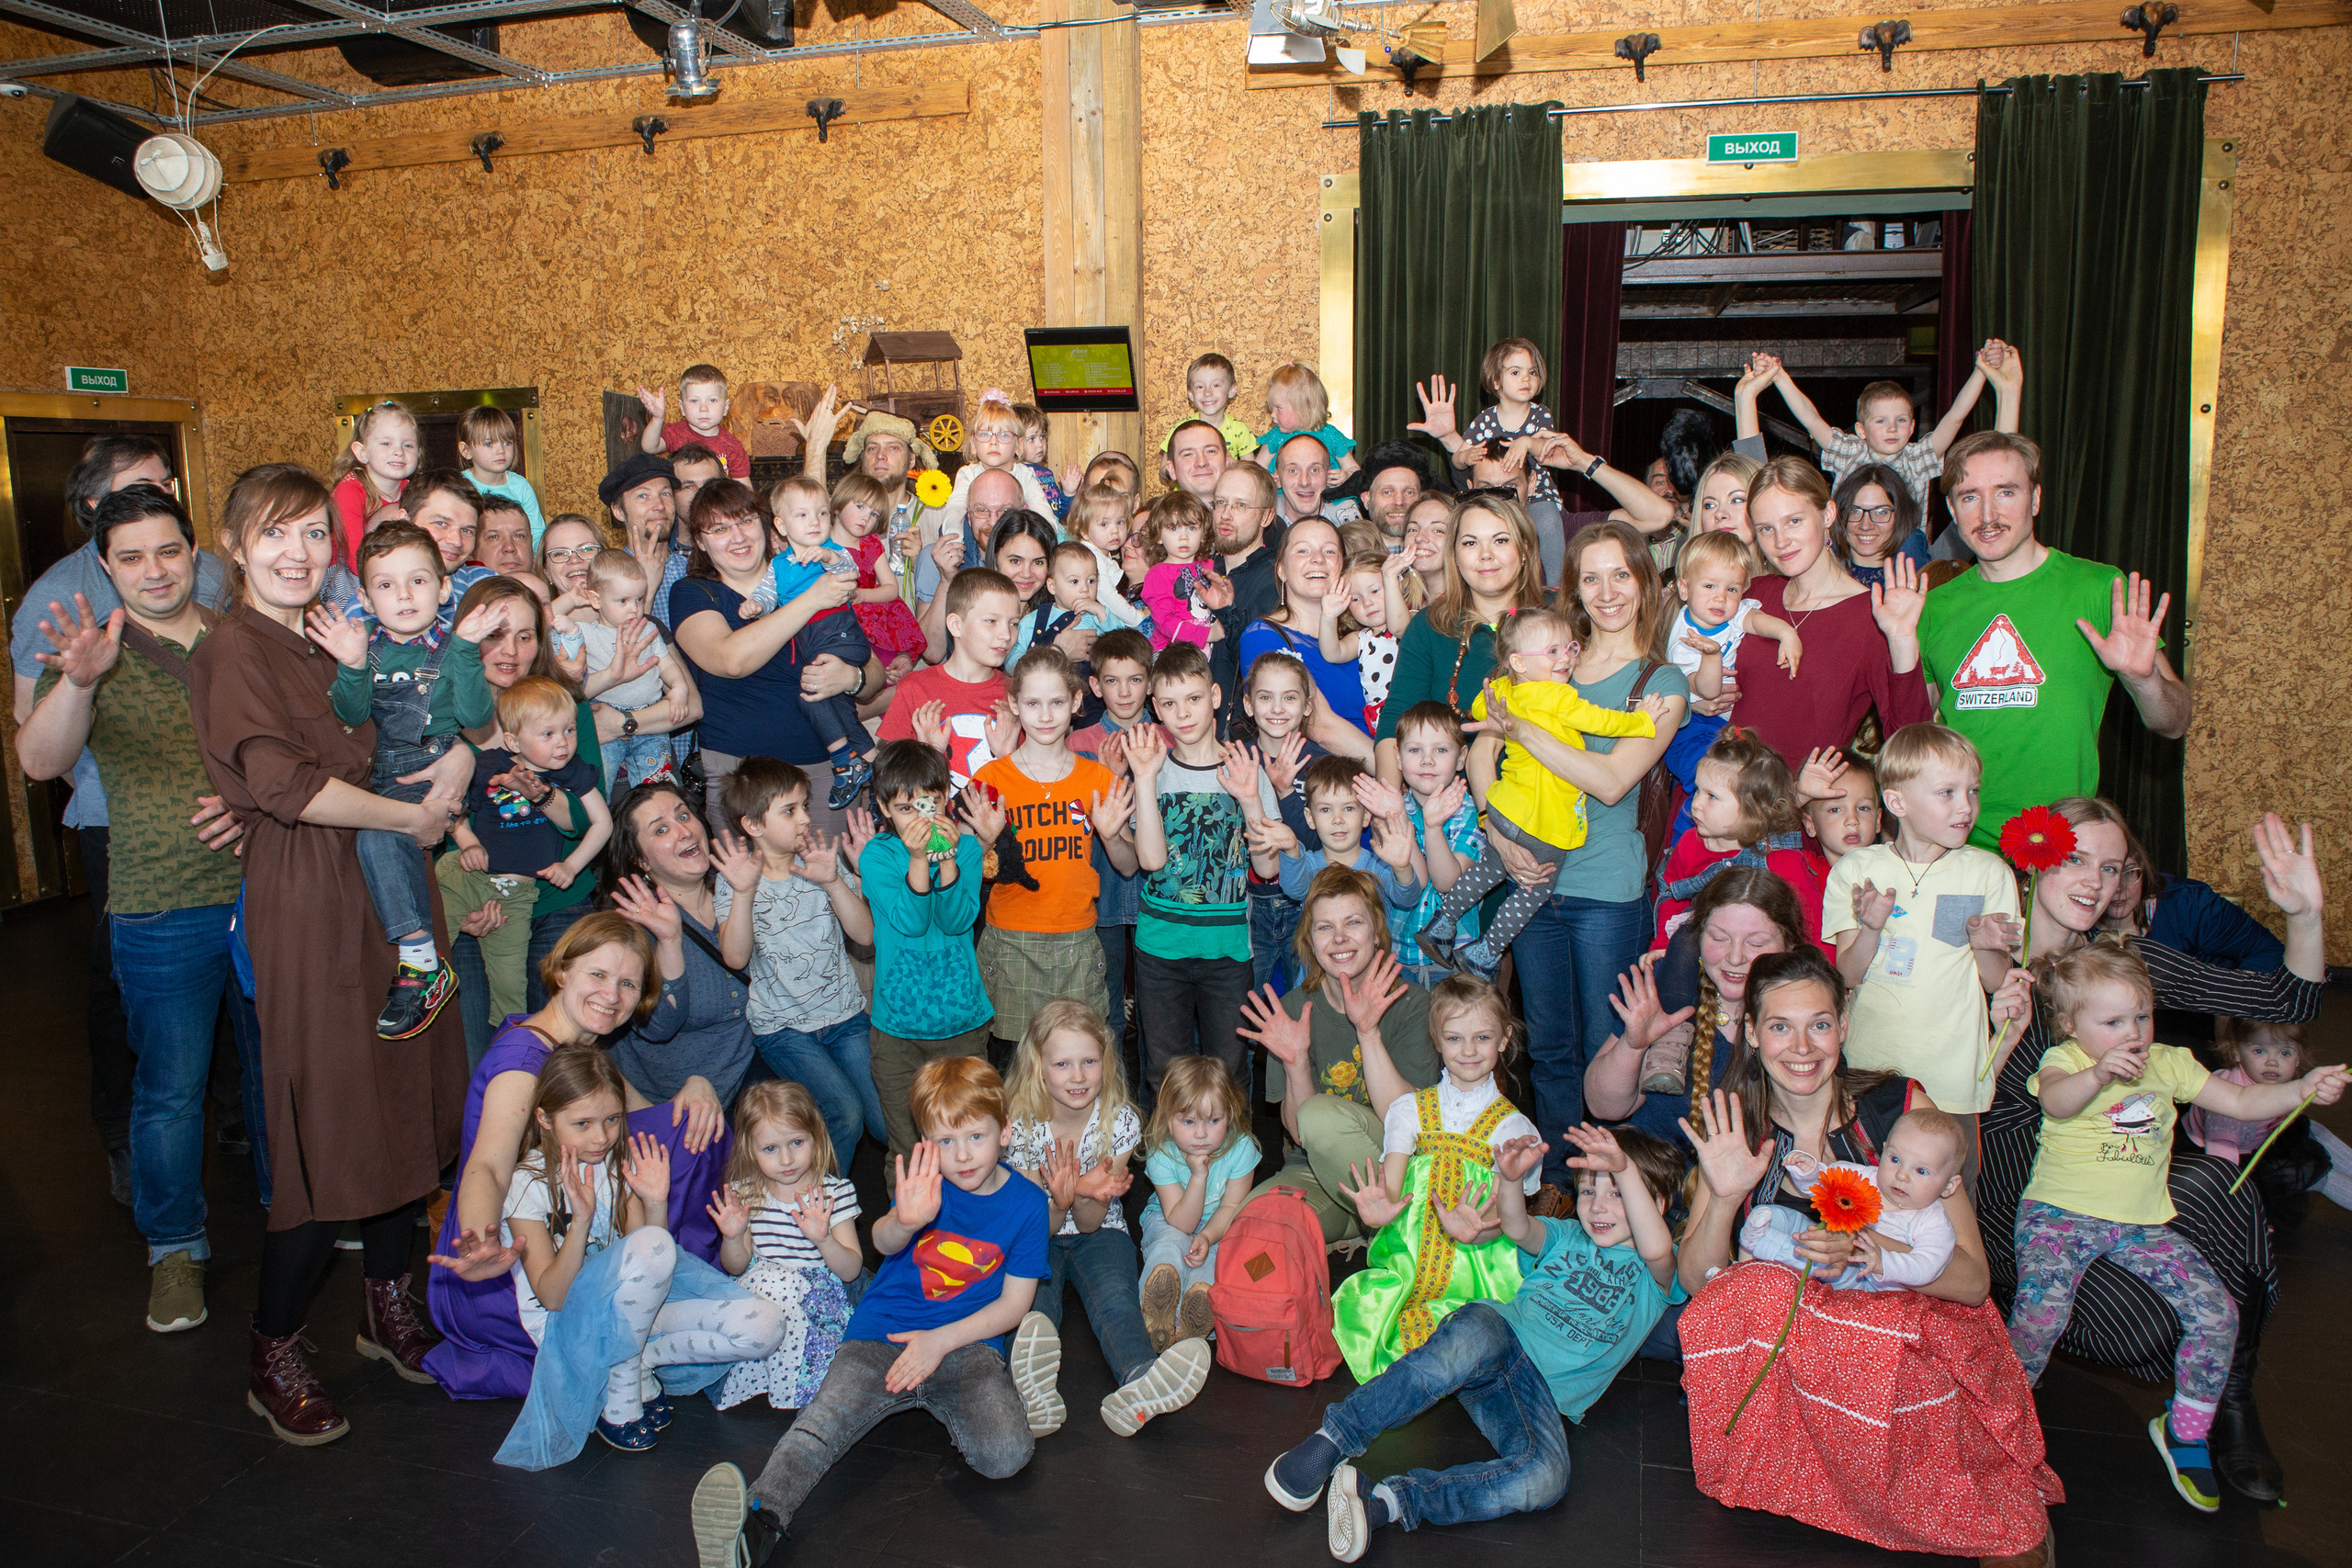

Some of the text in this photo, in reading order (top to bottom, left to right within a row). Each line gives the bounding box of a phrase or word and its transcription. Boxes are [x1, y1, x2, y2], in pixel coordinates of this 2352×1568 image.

[1724, 141, 1781, 155] ВЫХОД
[81, 375, 118, 388] ВЫХОД
[1958, 691, 2033, 705] SWITZERLAND
[1007, 801, 1067, 830] UTCH
[1024, 835, 1083, 863] OUPIE
[1544, 1250, 1589, 1280] NYC
[1606, 1273, 1626, 1286] ATH
[1544, 1312, 1594, 1348] USA DEPT
